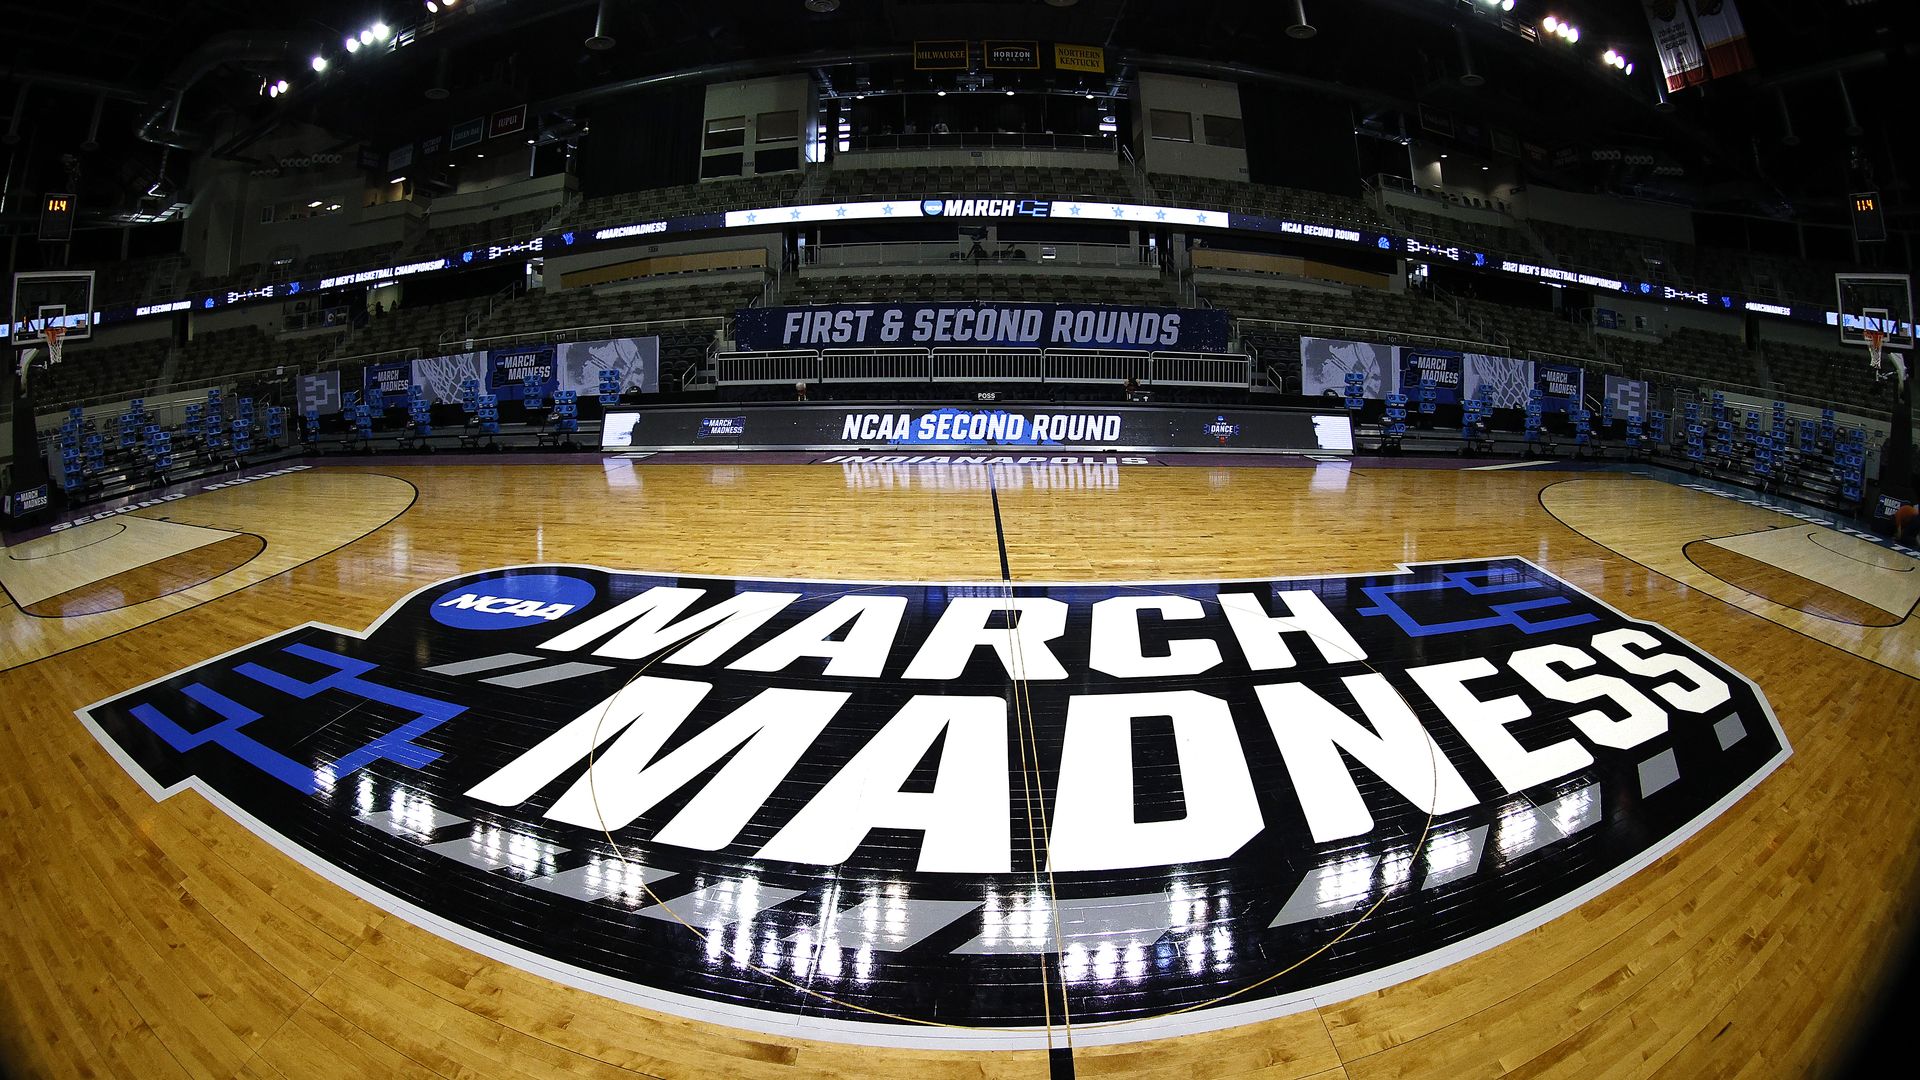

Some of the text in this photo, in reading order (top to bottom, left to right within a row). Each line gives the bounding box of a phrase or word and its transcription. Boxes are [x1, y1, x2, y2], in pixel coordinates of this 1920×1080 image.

[918, 50, 966, 60] MILWAUKEE
[1058, 48, 1100, 59] NORTHERN
[1060, 57, 1100, 68] KENTUCKY
[943, 199, 1016, 217] MARCH
[1856, 199, 1874, 211] 11.4
[595, 222, 668, 240] #MARCHMADNESS
[1281, 221, 1360, 242] NCAA SECOND ROUND
[319, 258, 446, 289] 2021 MEN'S BASKETBALL CHAMPIONSHIP
[1502, 261, 1622, 291] 2021 MEN'S BASKETBALL CHAMPIONSHIP
[782, 308, 1181, 345] FIRST & SECOND ROUNDS
[504, 354, 536, 369] MARCH
[1417, 356, 1448, 371] MARCH
[377, 369, 400, 382] MARCH
[507, 365, 551, 381] MADNESS
[1421, 369, 1459, 385] MADNESS
[1546, 370, 1568, 383] MARCH
[380, 379, 409, 392] MADNESS
[1549, 382, 1577, 395] MADNESS
[708, 419, 733, 427] MARCH
[710, 426, 743, 434] MADNESS
[841, 413, 1122, 442] NCAA SECOND ROUND
[1210, 424, 1234, 433] DANCE
[821, 454, 1149, 465] INDIANAPOLIS
[20, 489, 39, 503] MARCH
[23, 495, 48, 510] MADNESS
[50, 464, 312, 533] SECOND ROUND
[438, 593, 576, 621] NCAA
[536, 586, 1369, 682] MARCH
[462, 627, 1732, 875] MADNESS
